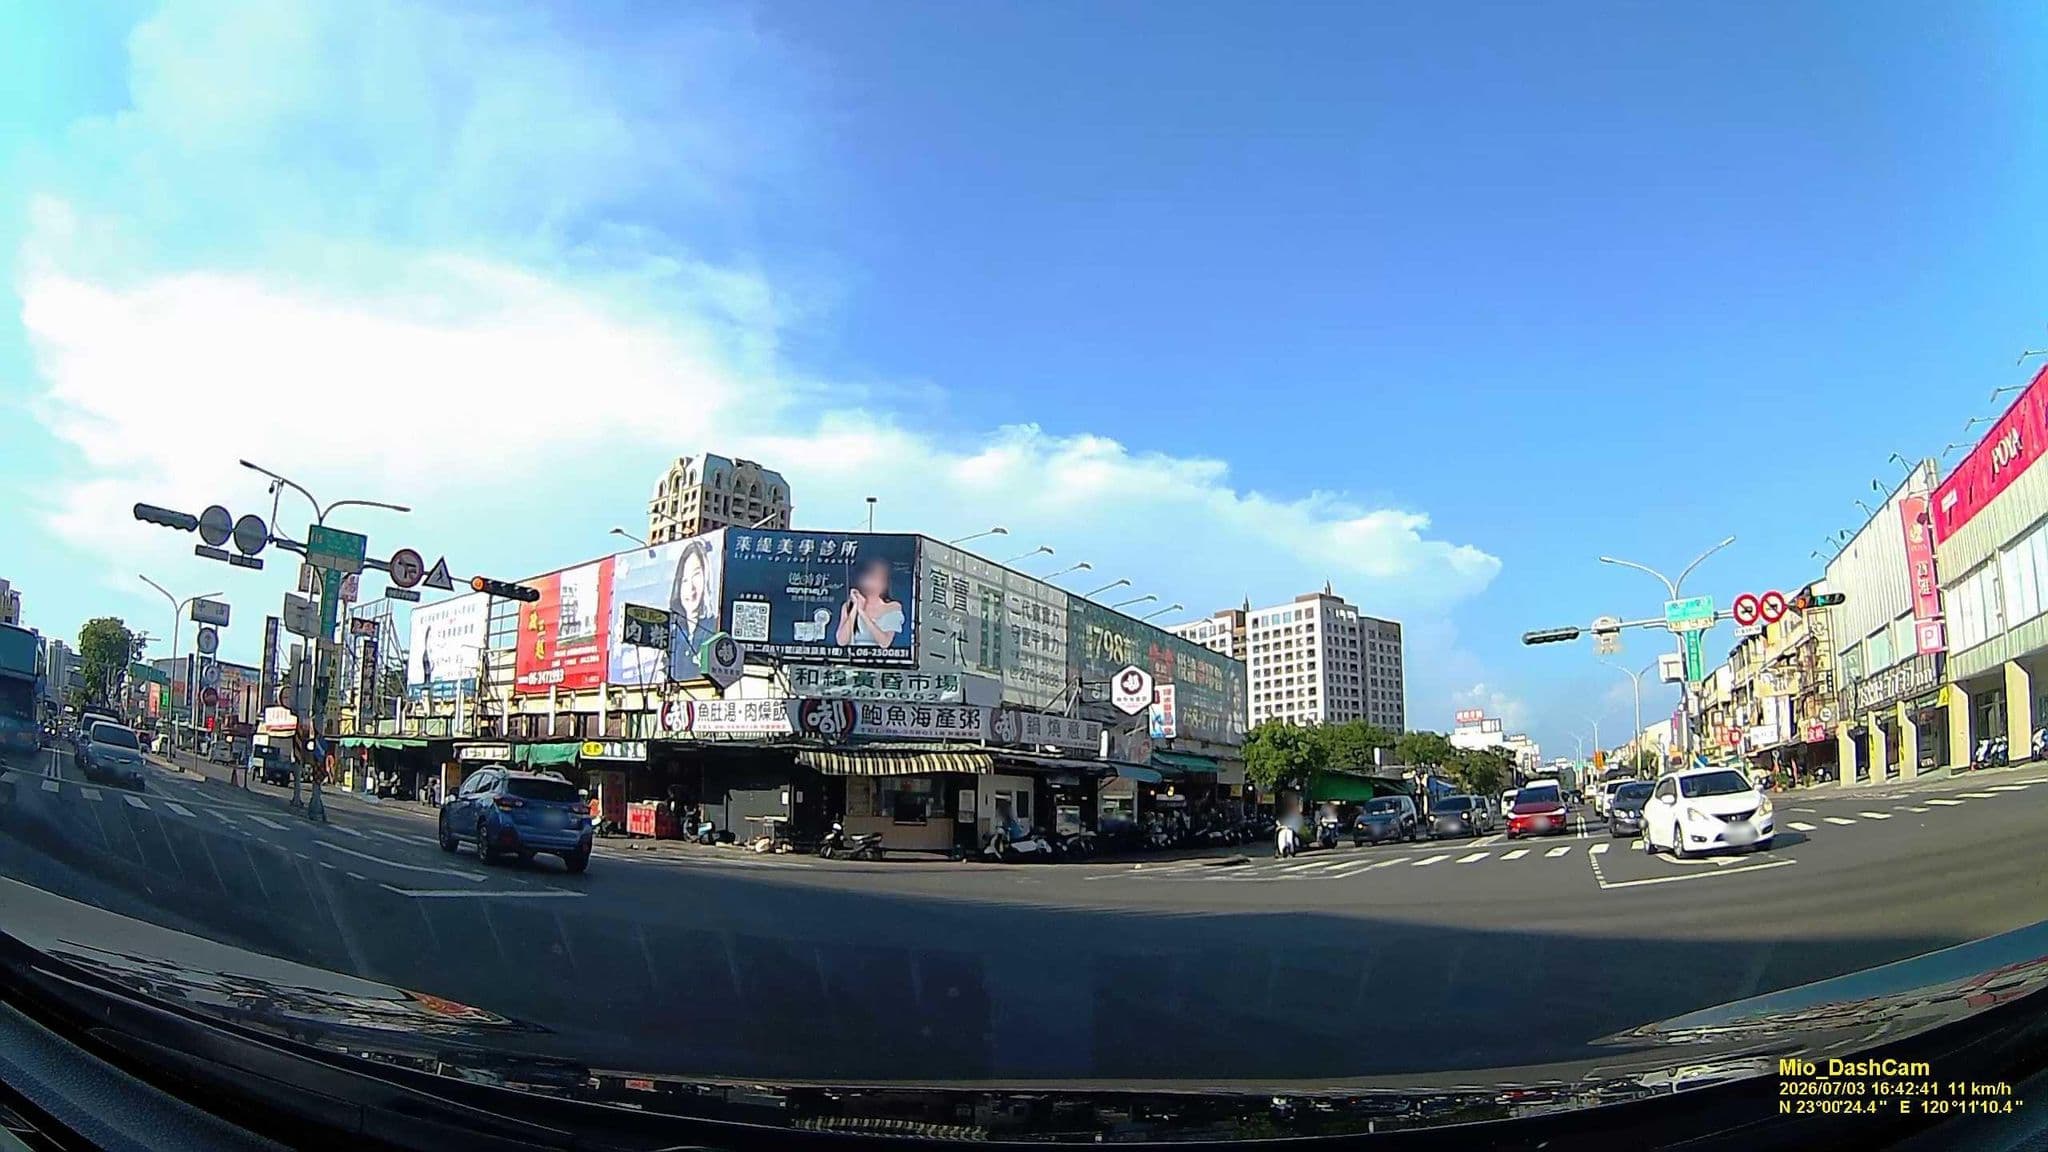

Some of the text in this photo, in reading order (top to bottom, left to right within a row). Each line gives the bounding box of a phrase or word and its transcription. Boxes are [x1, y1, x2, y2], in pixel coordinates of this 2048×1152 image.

[1991, 427, 2024, 474] POYA
[795, 666, 959, 693] 和緯黃昏市場
[861, 704, 982, 730] 鮑魚海產粥
